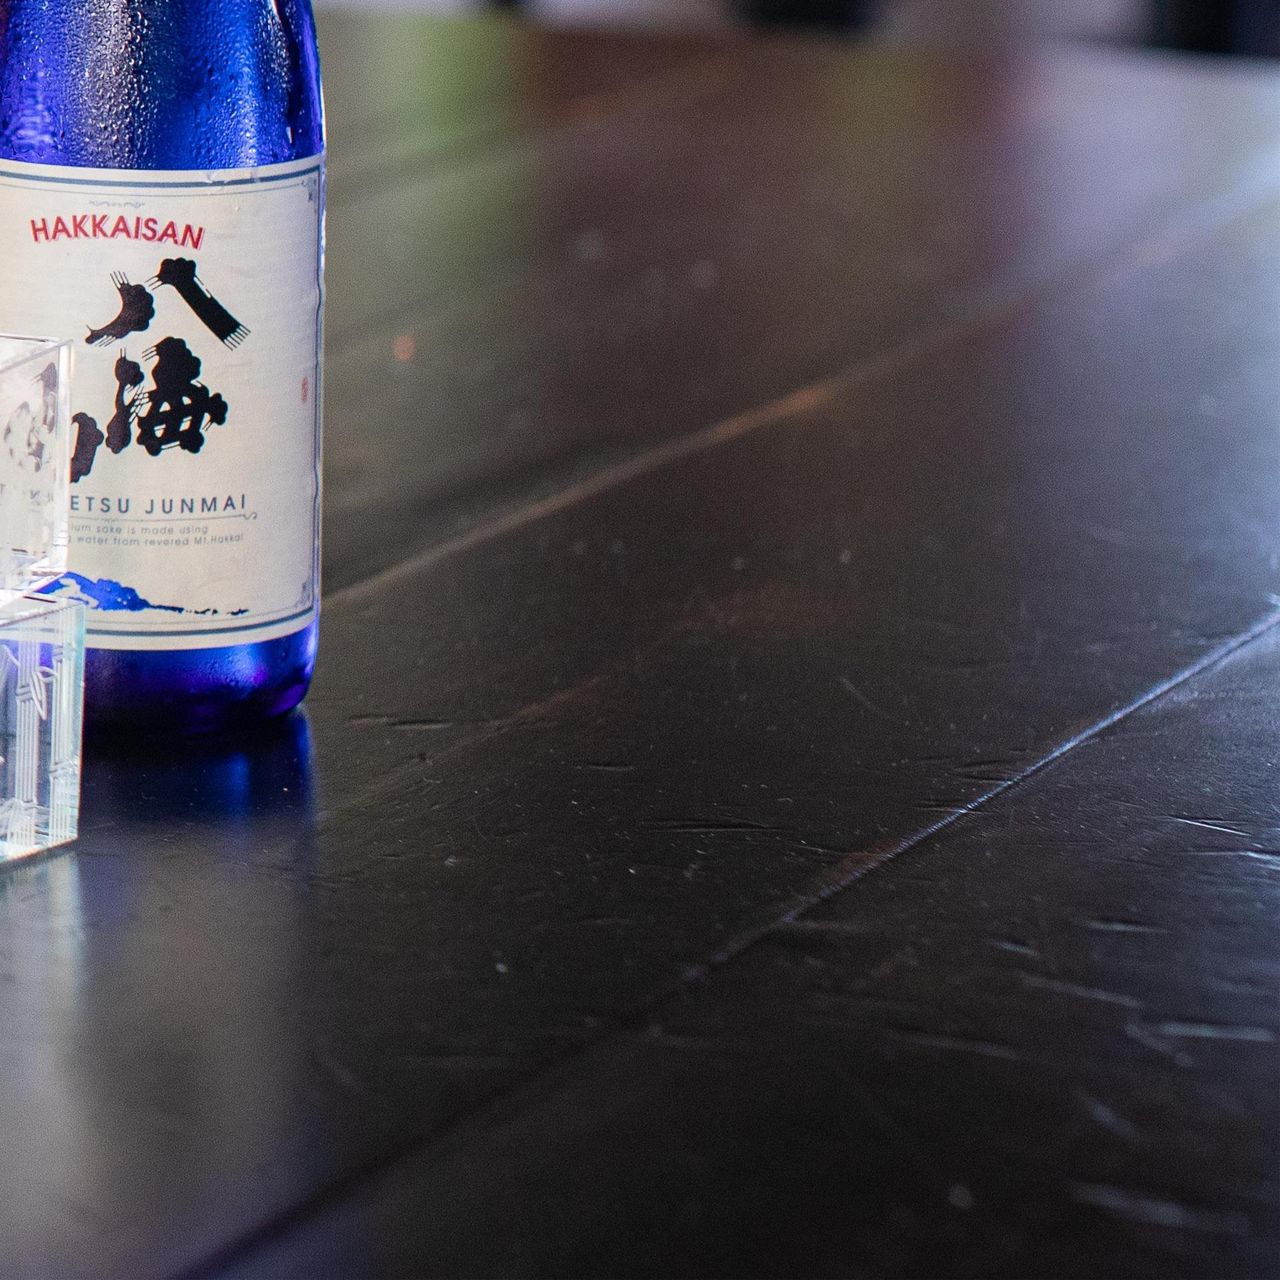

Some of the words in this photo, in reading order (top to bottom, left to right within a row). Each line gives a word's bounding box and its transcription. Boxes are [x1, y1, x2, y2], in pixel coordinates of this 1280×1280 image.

[31, 214, 205, 250] HAKKAISAN
[145, 494, 246, 515] JUNMAI
[96, 524, 122, 535] sake
[127, 524, 136, 535] is
[141, 524, 174, 535] made
[179, 524, 209, 536] using
[77, 534, 108, 546] water
[114, 534, 140, 547] from
[144, 535, 189, 547] revered
